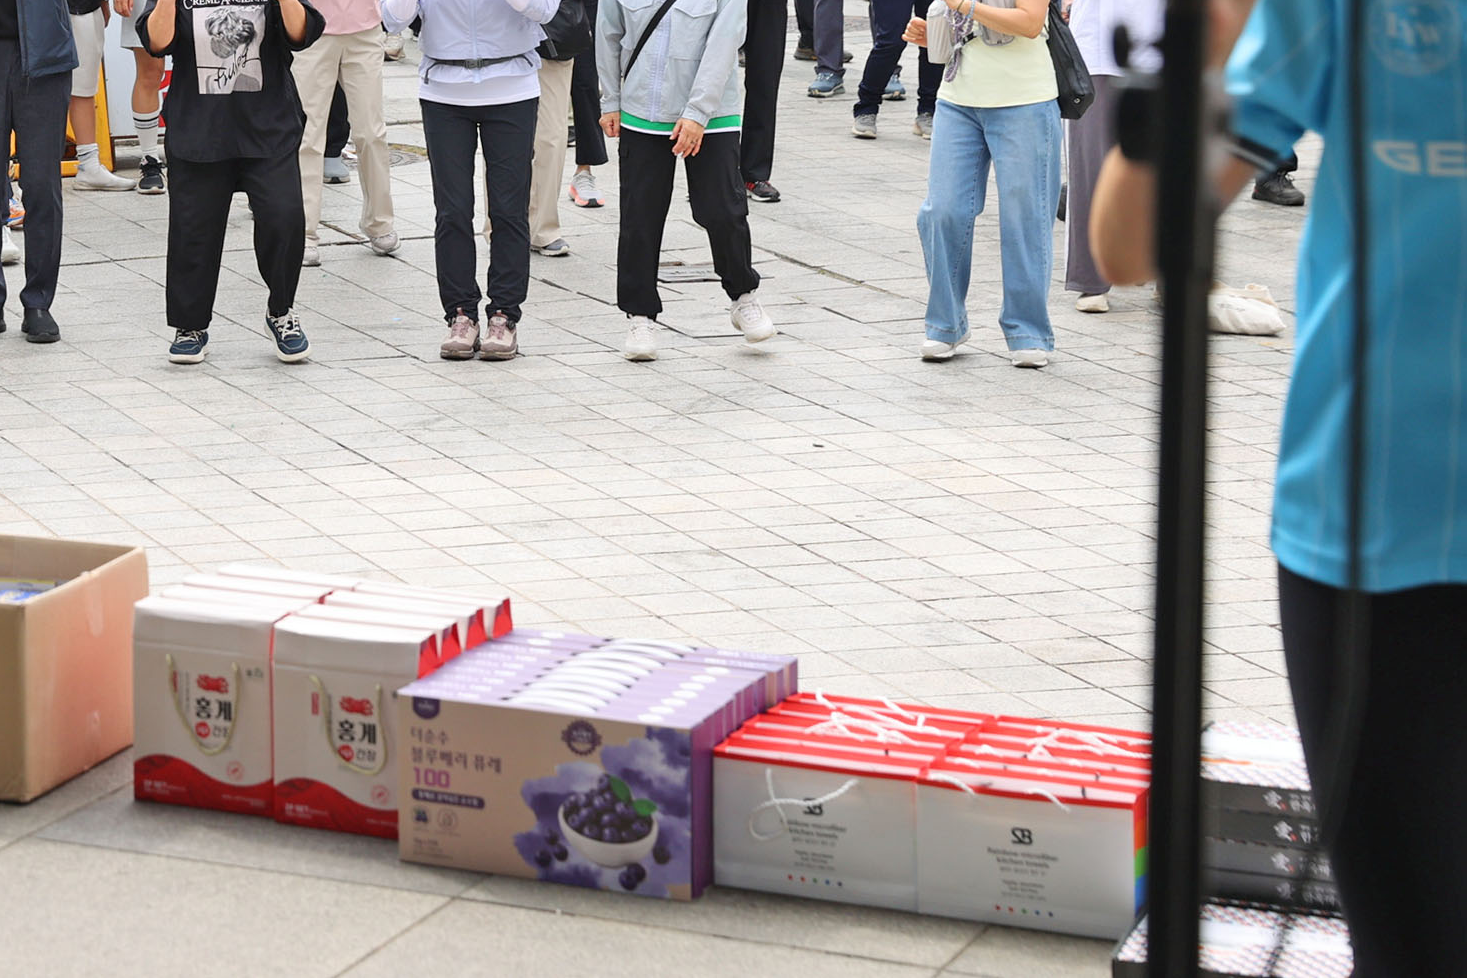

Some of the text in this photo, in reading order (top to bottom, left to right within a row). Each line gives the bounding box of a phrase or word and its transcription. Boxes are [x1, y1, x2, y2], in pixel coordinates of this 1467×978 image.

[195, 696, 232, 721] 홍게
[338, 719, 377, 745] 홍게
[411, 746, 469, 771] 블루베리
[413, 766, 451, 789] 100
